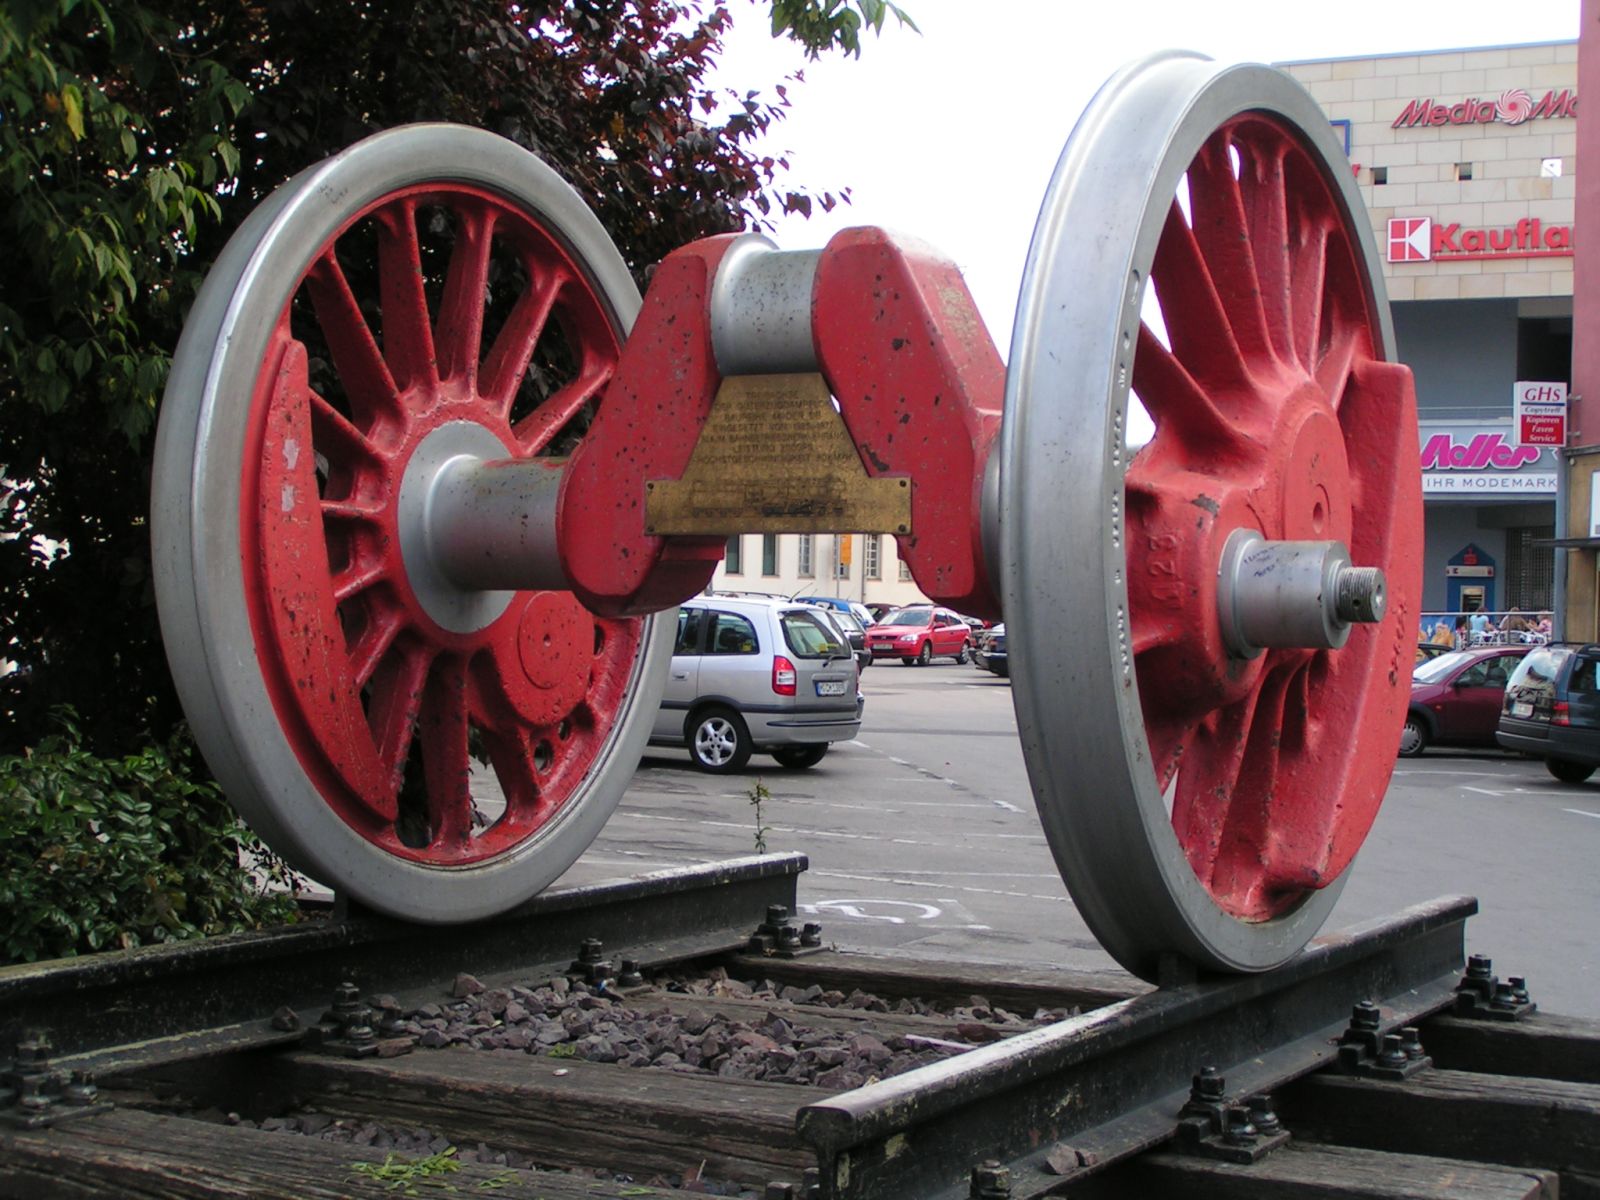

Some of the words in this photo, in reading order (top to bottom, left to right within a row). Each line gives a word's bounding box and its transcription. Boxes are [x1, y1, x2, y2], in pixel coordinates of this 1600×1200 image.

[1391, 98, 1497, 128] Media
[1432, 218, 1575, 253] Kaufla
[1525, 386, 1561, 401] GHS
[1526, 416, 1560, 425] Kopieren
[1529, 434, 1557, 442] Service
[1420, 433, 1541, 469] Adler
[1426, 478, 1455, 488] IHR
[1462, 478, 1557, 488] MODEMARK
